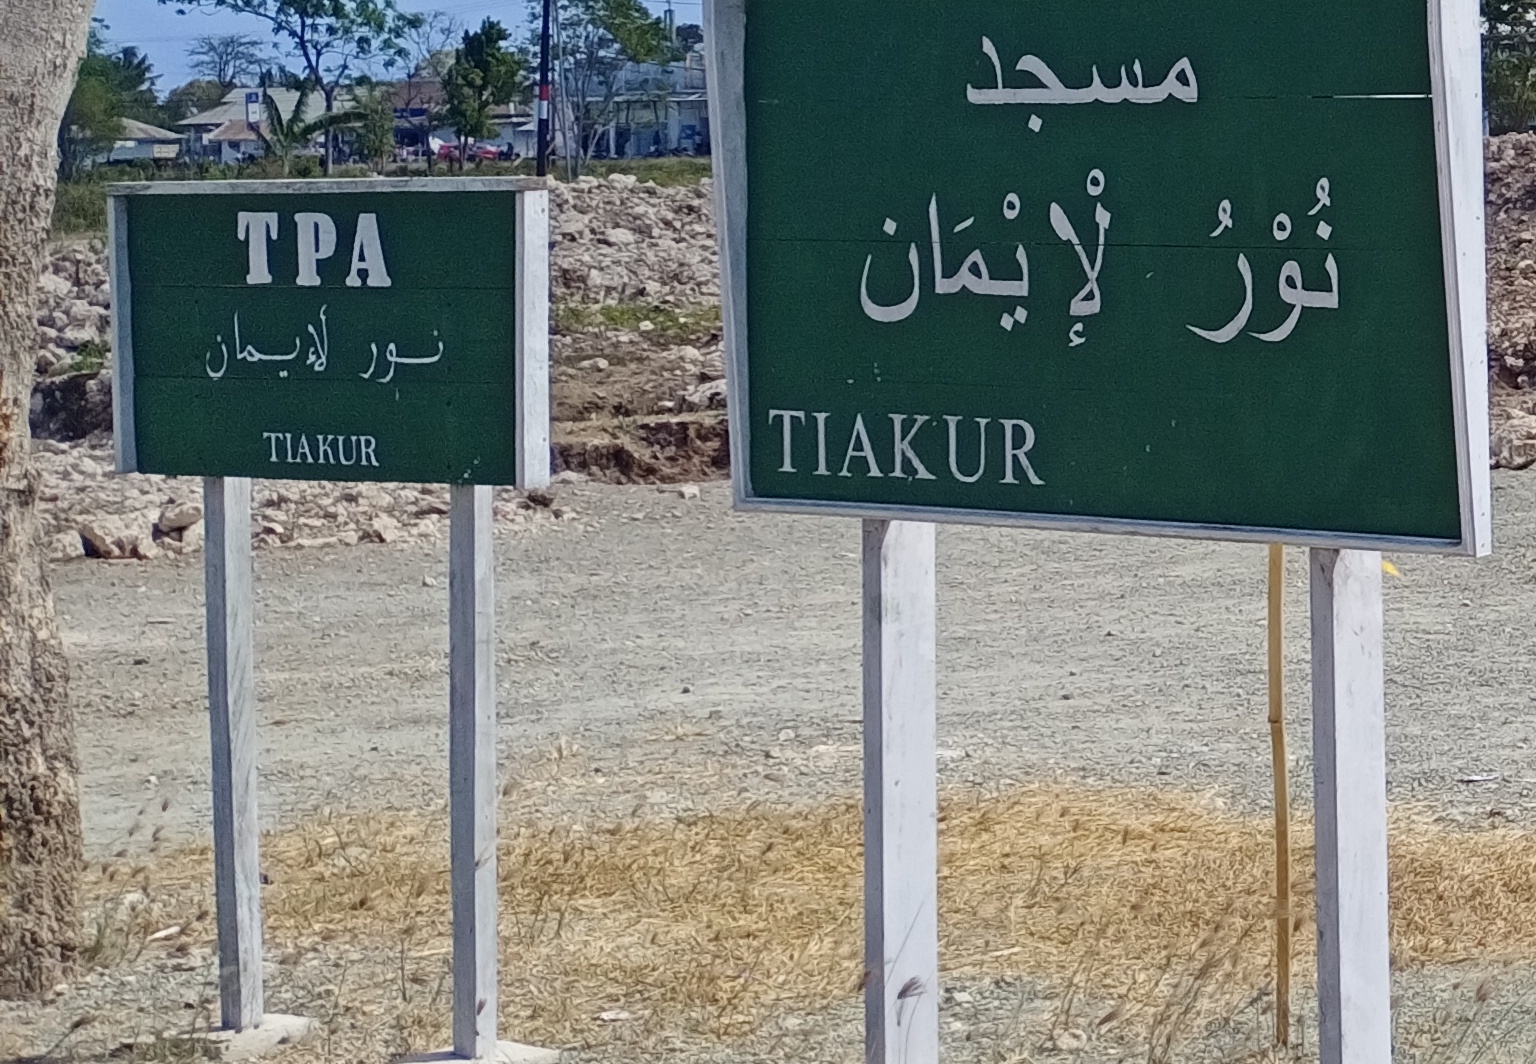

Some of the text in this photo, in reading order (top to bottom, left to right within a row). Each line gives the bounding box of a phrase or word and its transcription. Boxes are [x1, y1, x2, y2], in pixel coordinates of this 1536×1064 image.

[966, 36, 1198, 133] مسجد
[237, 211, 392, 287] TPA
[358, 330, 444, 383] نور
[262, 431, 380, 467] TIAKUR
[768, 408, 1045, 486] TIAKUR
